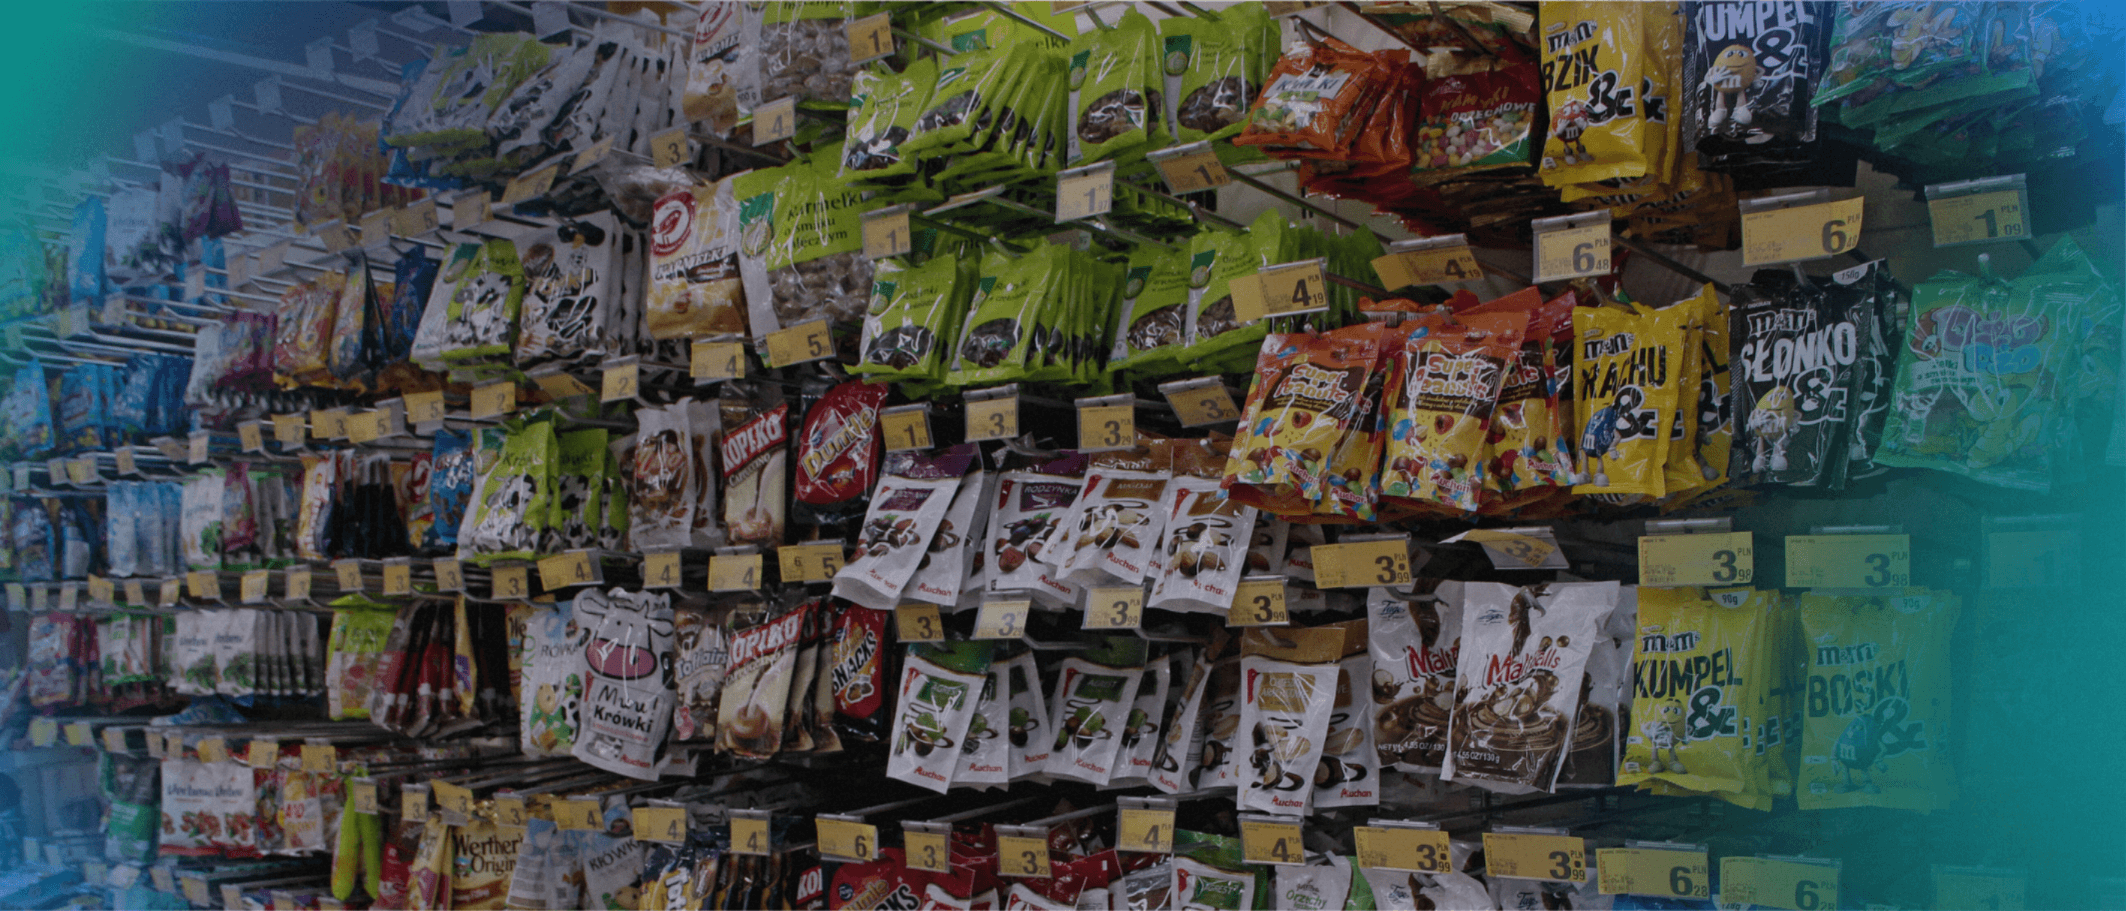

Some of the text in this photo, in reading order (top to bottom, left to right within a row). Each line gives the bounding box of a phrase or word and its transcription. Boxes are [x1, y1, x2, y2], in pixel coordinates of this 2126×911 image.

[868, 30, 880, 53] 1
[1543, 45, 1599, 92] BZIK
[771, 115, 782, 136] 4
[668, 143, 680, 164] 3
[1194, 165, 1213, 185] 1
[1084, 188, 1096, 213] 1
[1974, 210, 1997, 237] 1
[2004, 224, 2020, 235] 09
[886, 230, 897, 253] 1
[1821, 220, 1846, 253] 6
[1444, 258, 1466, 279] 4
[1573, 243, 1595, 273] 6
[1292, 279, 1311, 306] 4
[1311, 292, 1324, 304] 19
[807, 333, 823, 357] 5
[1740, 321, 1857, 382] SŁONKO
[725, 355, 736, 378] 4
[1289, 363, 1349, 386] Super
[1426, 352, 1484, 376] Super
[1200, 399, 1224, 419] 3
[904, 424, 916, 447] 1
[989, 413, 1004, 437] 3
[1104, 421, 1120, 446] 3
[801, 406, 876, 482] Dumle
[1025, 484, 1078, 495] RODZYNKA
[1108, 551, 1139, 573] Auchan
[1737, 547, 1751, 557] PLN
[575, 562, 585, 581] 4
[660, 565, 671, 584] 4
[742, 566, 754, 586] 4
[823, 556, 837, 579] 5
[1375, 556, 1395, 584] 3
[1396, 572, 1409, 582] 99
[1712, 549, 1737, 582] 3
[1738, 569, 1752, 581] 98
[1864, 553, 1891, 587] 3
[509, 577, 520, 596] 3
[918, 583, 951, 597] Auchan
[1040, 574, 1071, 594] Auchan
[1110, 601, 1127, 626] 3
[1253, 596, 1273, 622] 3
[916, 616, 931, 639] 3
[1000, 613, 1016, 636] 3
[1633, 648, 1743, 700] KUMPEL
[1808, 659, 1910, 719] BOSKI
[594, 705, 654, 733] Krówki
[914, 767, 946, 783] Auchan
[969, 763, 1002, 773] Auchan
[1341, 789, 1372, 799] Auchan
[511, 808, 521, 826] 3
[587, 810, 597, 828] 4
[667, 820, 678, 839] 4
[747, 831, 758, 851] 4
[1143, 825, 1160, 850] 4
[455, 832, 524, 856] Werther'
[855, 835, 867, 858] 6
[1271, 838, 1290, 862] 4
[1571, 850, 1583, 858] PLN
[922, 845, 936, 868] 3
[1022, 851, 1038, 875] 3
[1415, 845, 1438, 870] 3
[1437, 861, 1451, 871] 99
[1548, 851, 1571, 879] 3
[1572, 868, 1585, 880] 99
[1669, 866, 1693, 896] 6
[1693, 886, 1708, 897] 28
[1795, 879, 1820, 911] 6
